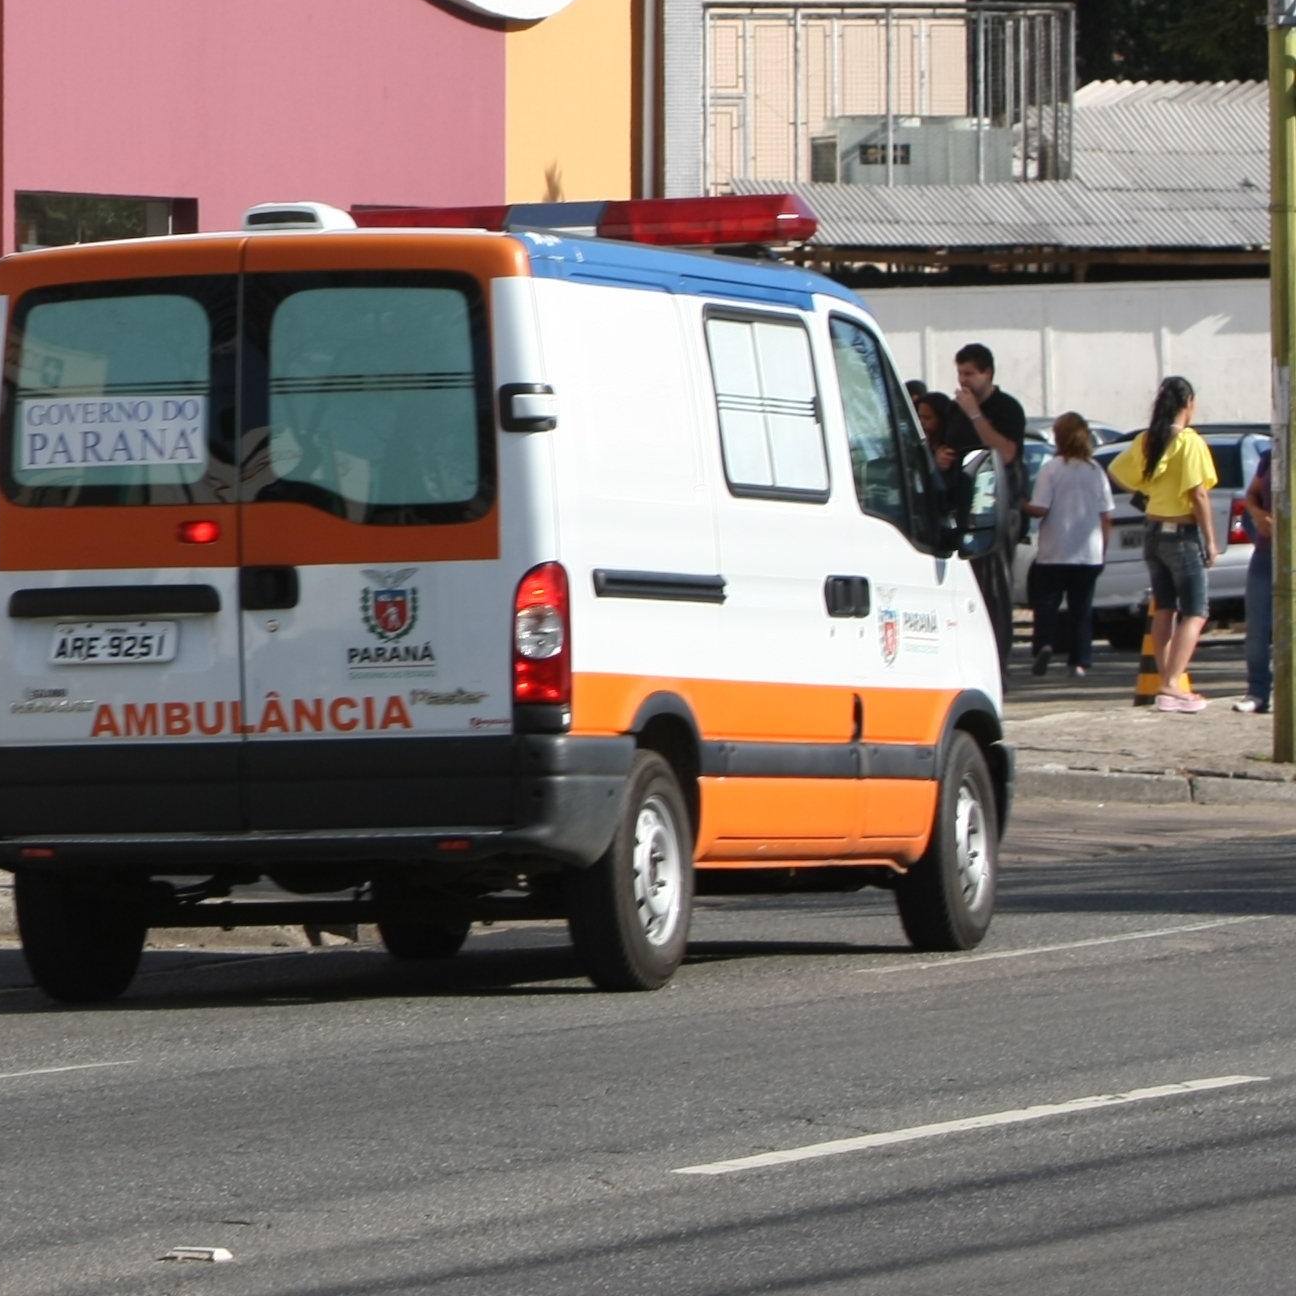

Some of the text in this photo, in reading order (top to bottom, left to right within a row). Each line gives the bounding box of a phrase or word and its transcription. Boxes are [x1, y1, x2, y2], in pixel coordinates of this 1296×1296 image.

[25, 398, 201, 427] GOVERNO DO
[26, 426, 200, 466] PARANÁ
[346, 641, 437, 665] PARANÁ
[90, 689, 413, 739] AMBULÂNCIA
